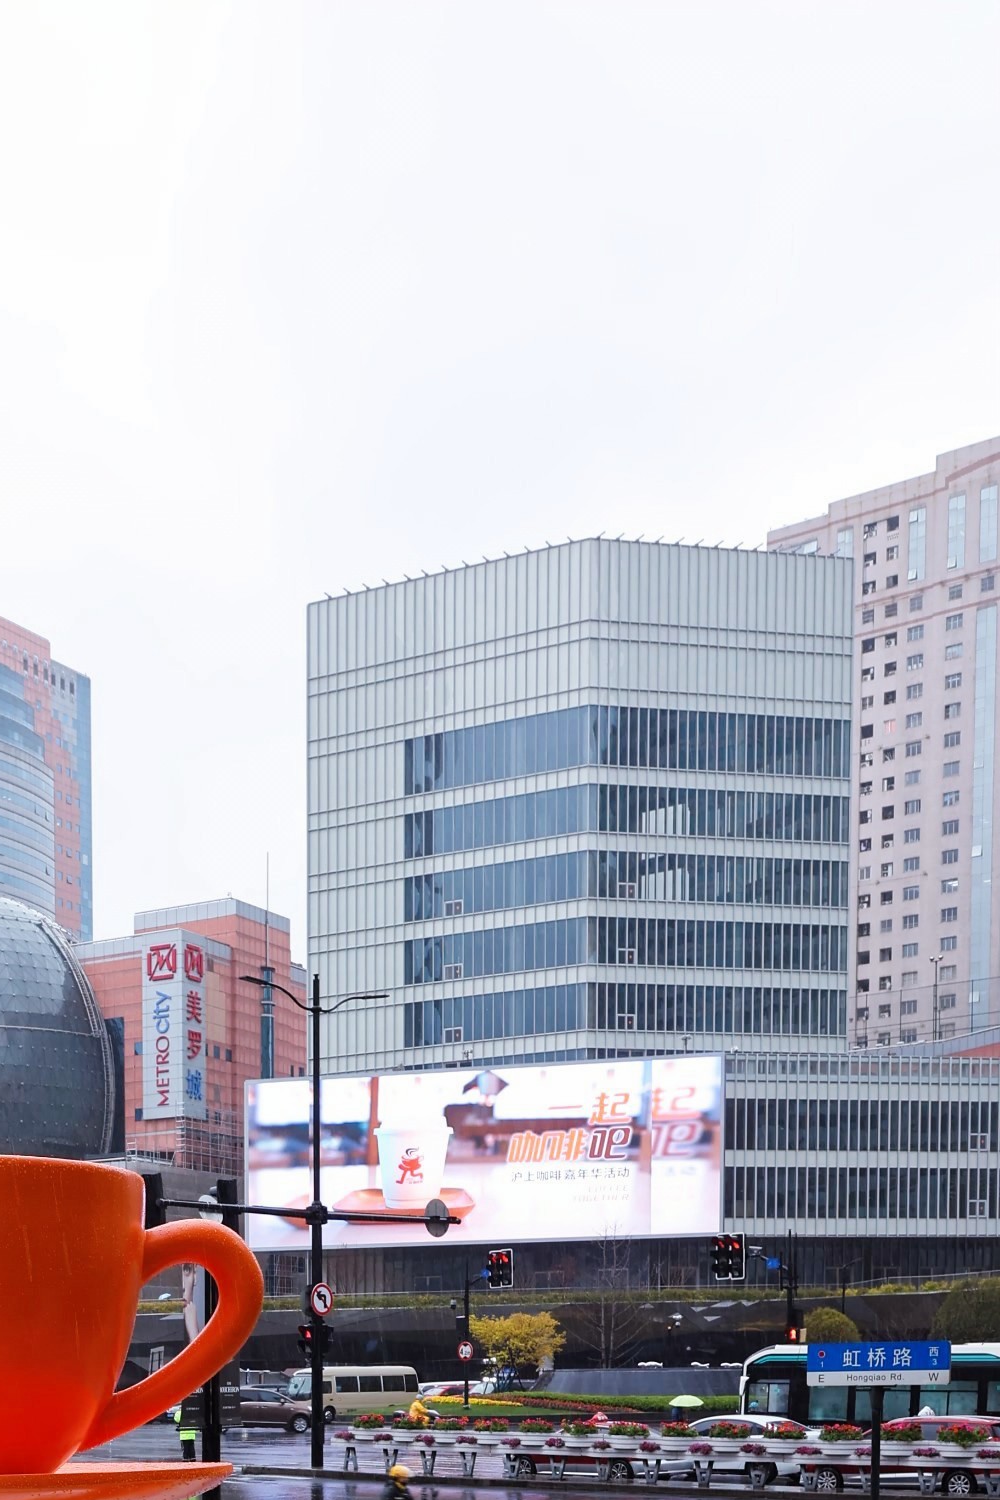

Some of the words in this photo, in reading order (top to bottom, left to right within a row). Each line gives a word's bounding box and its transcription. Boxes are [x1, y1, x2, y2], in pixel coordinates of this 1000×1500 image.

[185, 990, 202, 1101] 美罗城
[548, 1092, 632, 1126] 一起
[507, 1126, 632, 1164] 咖啡吧
[511, 1167, 630, 1182] 沪上咖啡嘉年华活动
[842, 1347, 912, 1367] 虹桥路
[928, 1346, 940, 1357] 西
[932, 1358, 938, 1366] 3
[818, 1374, 825, 1383] E
[846, 1373, 886, 1383] Hongqiao
[890, 1373, 905, 1381] Rd.
[928, 1372, 940, 1382] W
